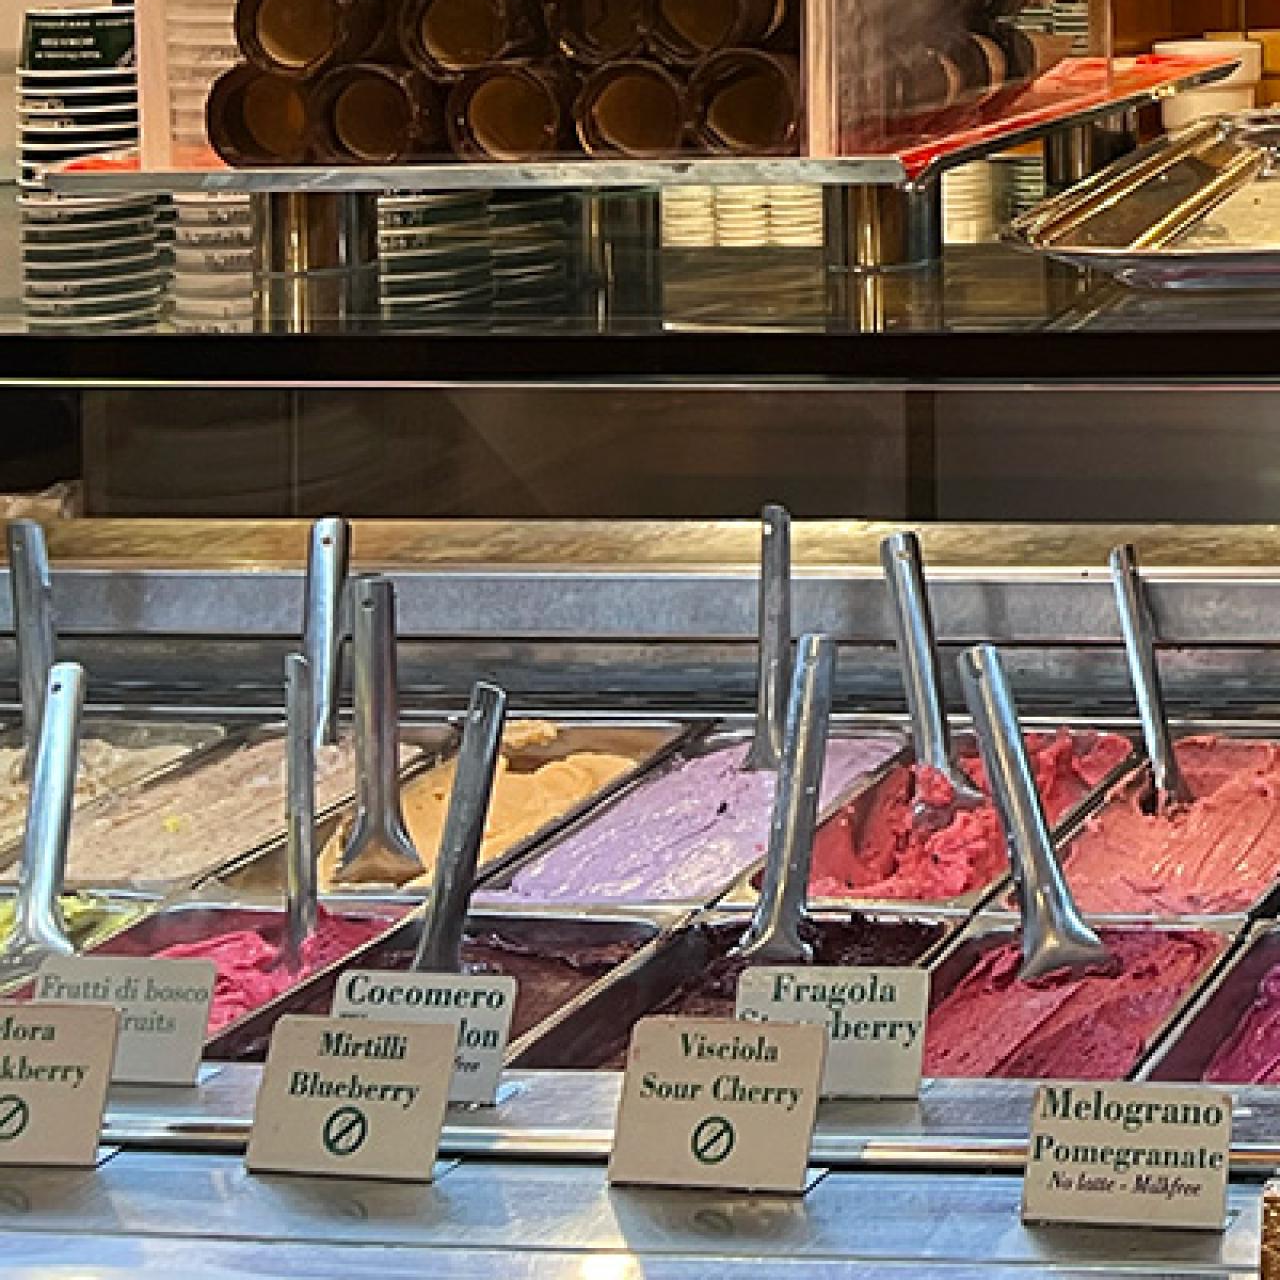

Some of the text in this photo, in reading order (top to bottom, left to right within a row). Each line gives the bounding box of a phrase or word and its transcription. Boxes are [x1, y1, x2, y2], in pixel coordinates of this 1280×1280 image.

[39, 975, 209, 1002] Frutti di bosco
[346, 975, 506, 1010] Cocomero
[771, 972, 896, 1009] Fragola
[318, 1031, 408, 1061] Mirtilli
[681, 1032, 780, 1065] Visciola
[288, 1071, 419, 1109] Blueberry
[639, 1073, 802, 1110] Sour Cherry
[1040, 1087, 1223, 1132] Melograno
[1033, 1135, 1224, 1173] Pomegranate
[1049, 1171, 1072, 1189] No
